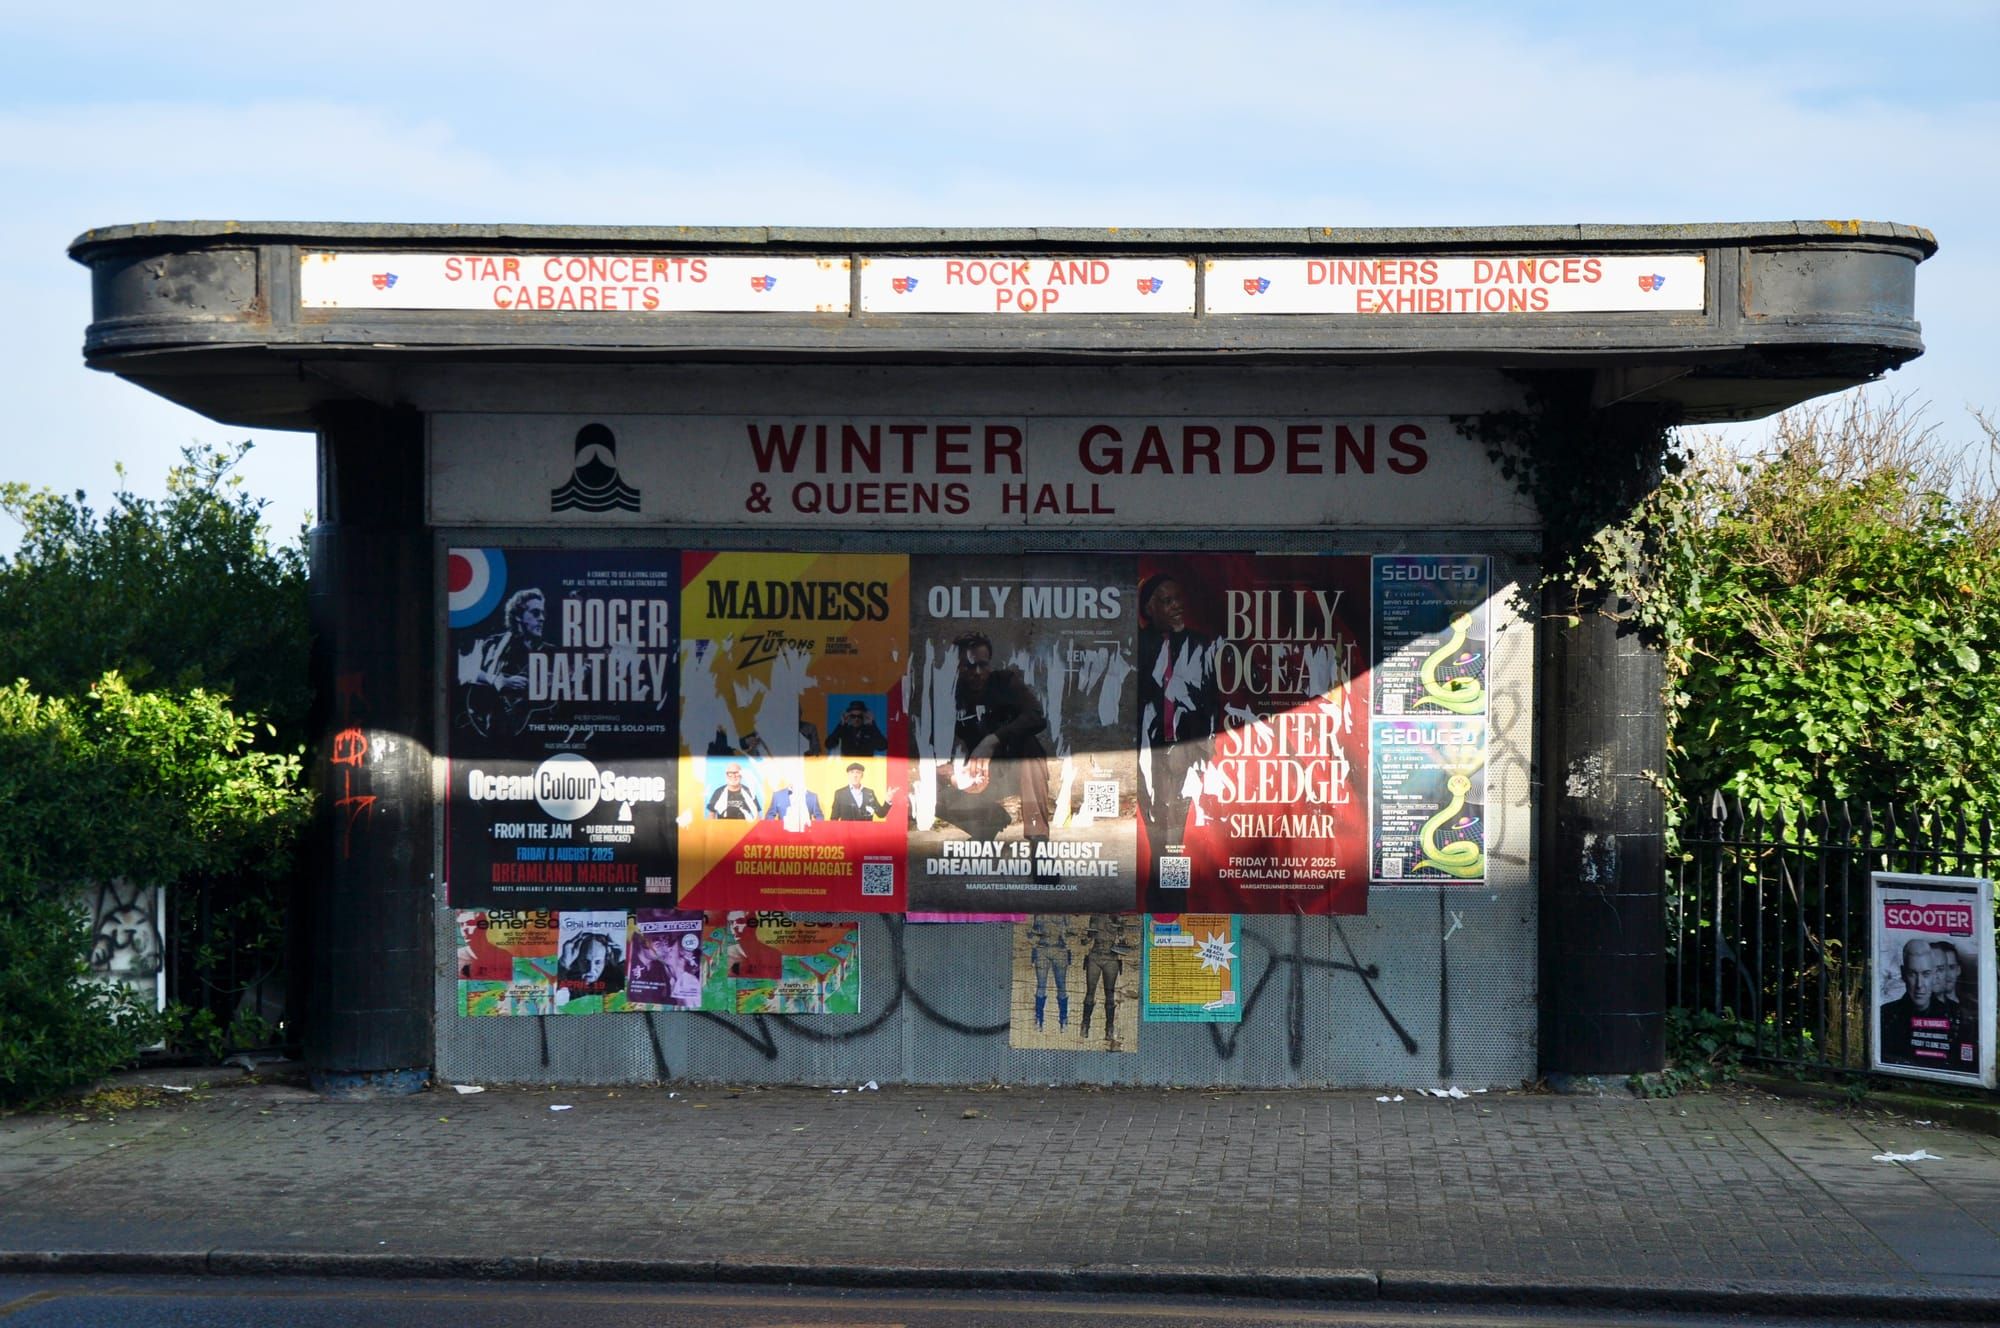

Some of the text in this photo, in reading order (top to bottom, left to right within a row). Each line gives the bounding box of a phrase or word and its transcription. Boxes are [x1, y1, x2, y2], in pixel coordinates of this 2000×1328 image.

[445, 257, 708, 283] STAR CONCERTS
[946, 259, 1110, 285] ROCK AND
[1307, 258, 1602, 285] DINNERS DANCES
[493, 285, 660, 310] CABARETS
[996, 288, 1059, 311] POP
[1356, 288, 1548, 313] EXHIBITIONS
[746, 423, 1429, 475] WINTER GARDENS
[746, 481, 1115, 515] & QUEENS HALL
[1381, 565, 1478, 581] SEDUCED
[706, 580, 889, 621] MADNESS
[928, 585, 1121, 619] OLLY MURS
[562, 598, 669, 648] ROGER
[1224, 590, 1345, 641] BILLY
[528, 652, 668, 702] DALTREY
[528, 724, 546, 732] THE
[575, 724, 612, 732] RARITIES
[1223, 712, 1343, 757] SISTER
[1381, 728, 1477, 745] SEDUCED
[469, 769, 665, 802] Ocean Colour Scene
[1217, 759, 1349, 804] SLEDGE
[494, 823, 572, 840] FROM THE JAM
[586, 825, 594, 834] DJ
[1230, 815, 1335, 838] SHALAMAR
[516, 847, 547, 861] FRIDAY
[556, 847, 590, 861] AUGUST
[591, 847, 614, 862] 2025
[743, 844, 845, 860] SAT 2 AUGUST 2025
[943, 840, 1103, 859] FRIDAY 15 AUGUST
[492, 863, 640, 884] DREAMLAND MARGATE
[735, 861, 852, 876] DREAMLAND MARGATE
[926, 858, 1119, 877] DREAMLAND MARGATE
[1229, 857, 1336, 867] FRIDAY 11 JULY 2025
[1219, 869, 1346, 880] DREAMLAND MARGATE
[1888, 909, 1969, 928] SCOOTER
